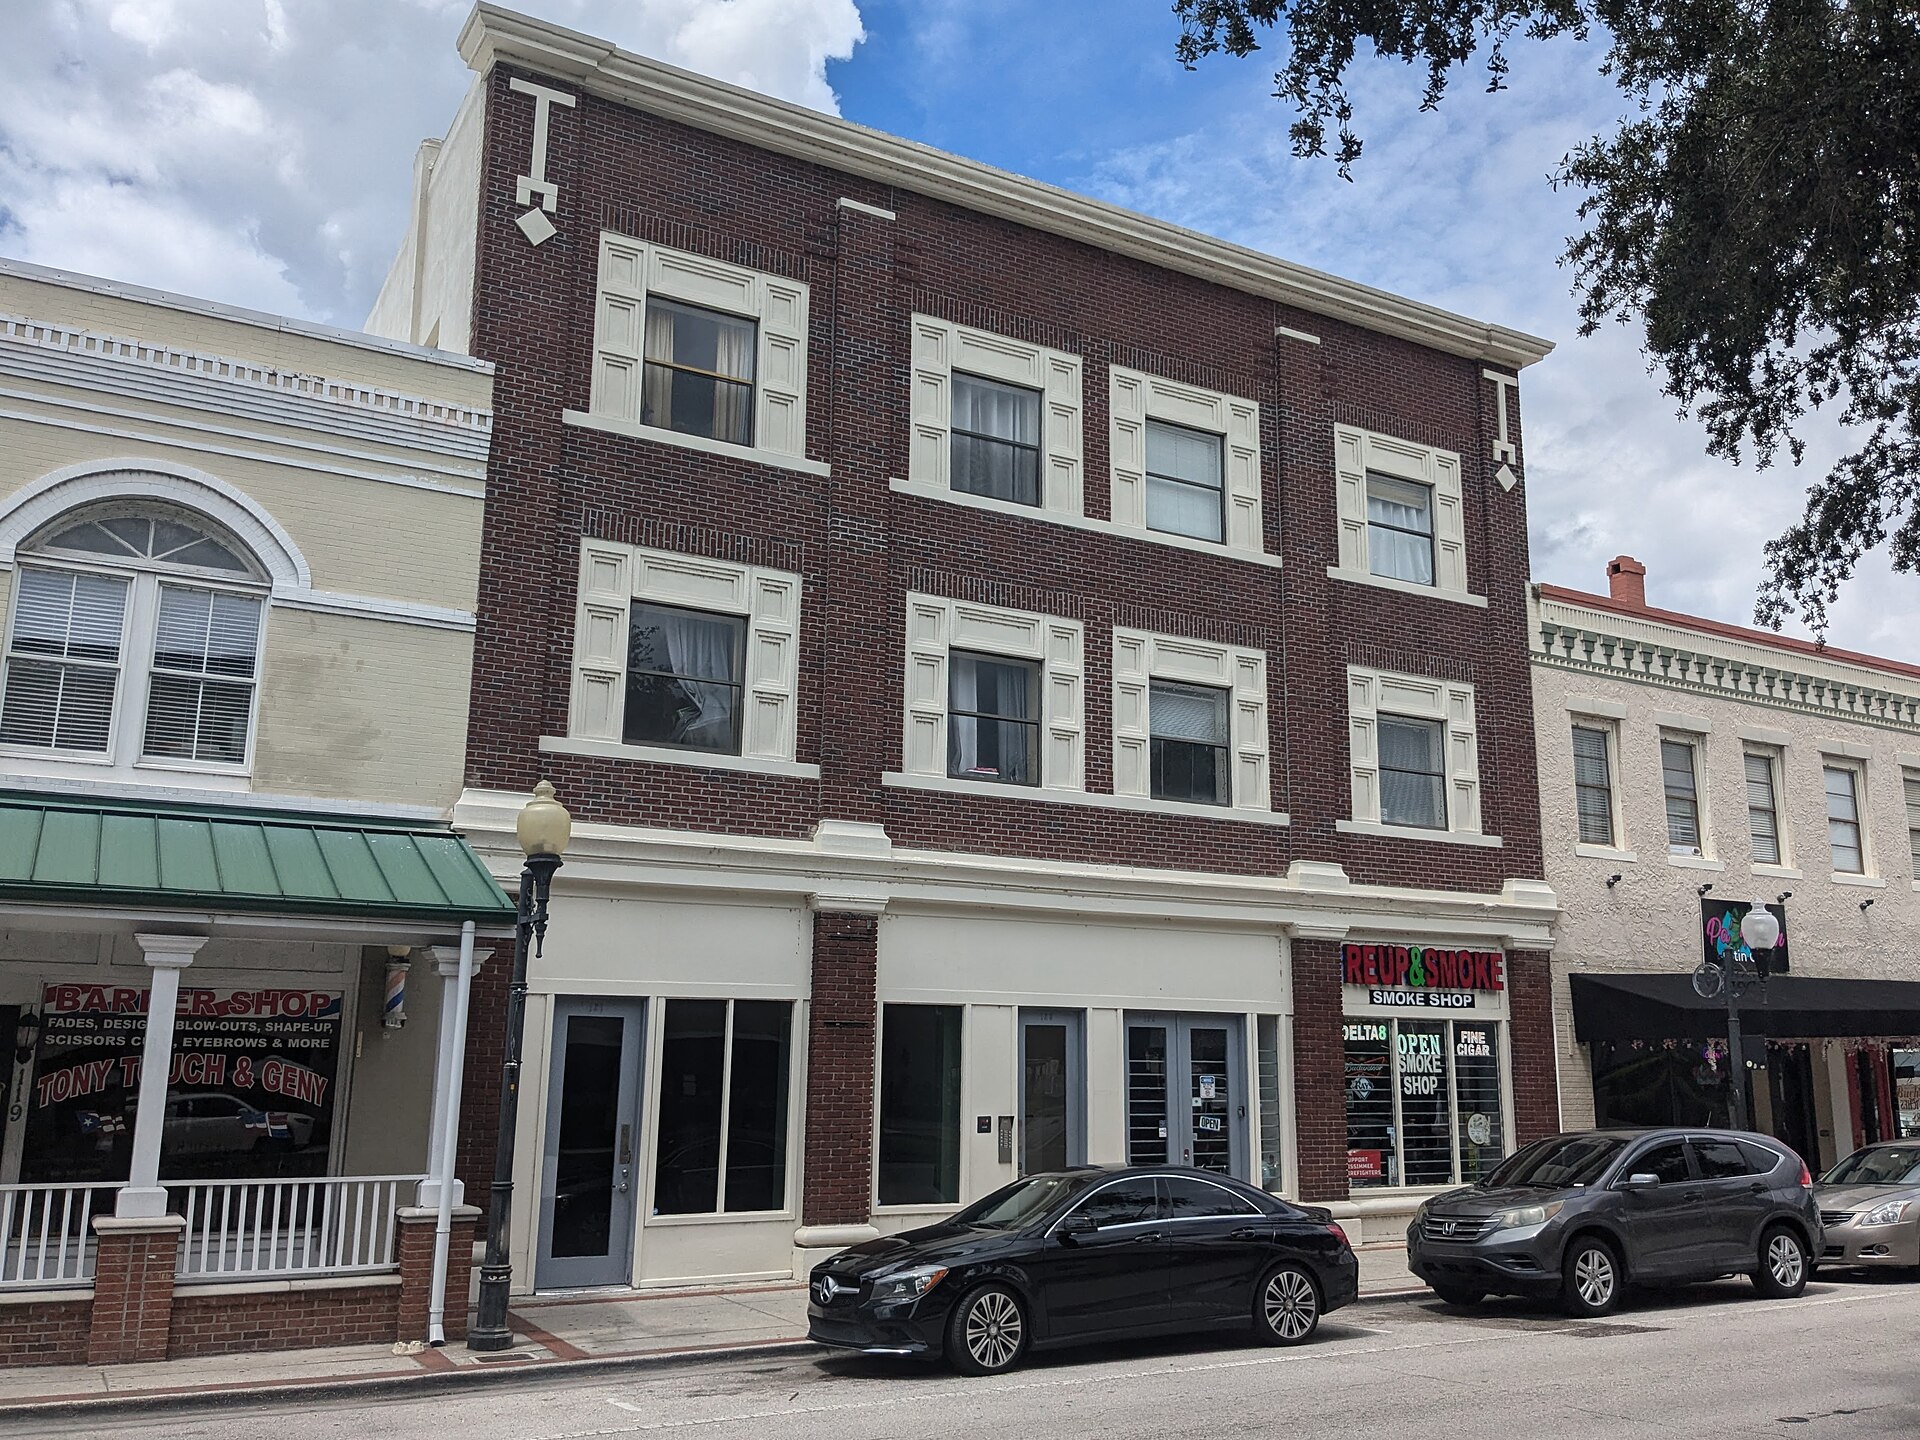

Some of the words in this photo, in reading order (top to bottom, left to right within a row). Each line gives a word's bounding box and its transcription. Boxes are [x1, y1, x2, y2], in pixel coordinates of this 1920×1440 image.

[229, 990, 332, 1017] SHOP
[1373, 991, 1425, 1006] SMOKE
[1429, 993, 1473, 1008] SHOP
[48, 1018, 98, 1031] FADES,
[103, 1018, 148, 1030] DESIG
[175, 1020, 261, 1034] BLOW-OUTS,
[265, 1022, 333, 1035] SHAPE-UP,
[44, 1034, 126, 1046] SCISSORS
[182, 1037, 270, 1049] EYEBROWS
[272, 1037, 283, 1048] &
[287, 1038, 331, 1049] MORE
[1397, 1033, 1441, 1055] OPEN
[1461, 1031, 1486, 1044] FINE
[1456, 1043, 1490, 1056] CIGAR
[1399, 1054, 1443, 1073] SMOKE
[37, 1059, 115, 1108] TONY
[120, 1053, 226, 1088] TUCH
[233, 1055, 254, 1089] &
[262, 1060, 328, 1107] GENY
[1404, 1075, 1438, 1095] SHOP
[1200, 1117, 1220, 1130] OPEN
